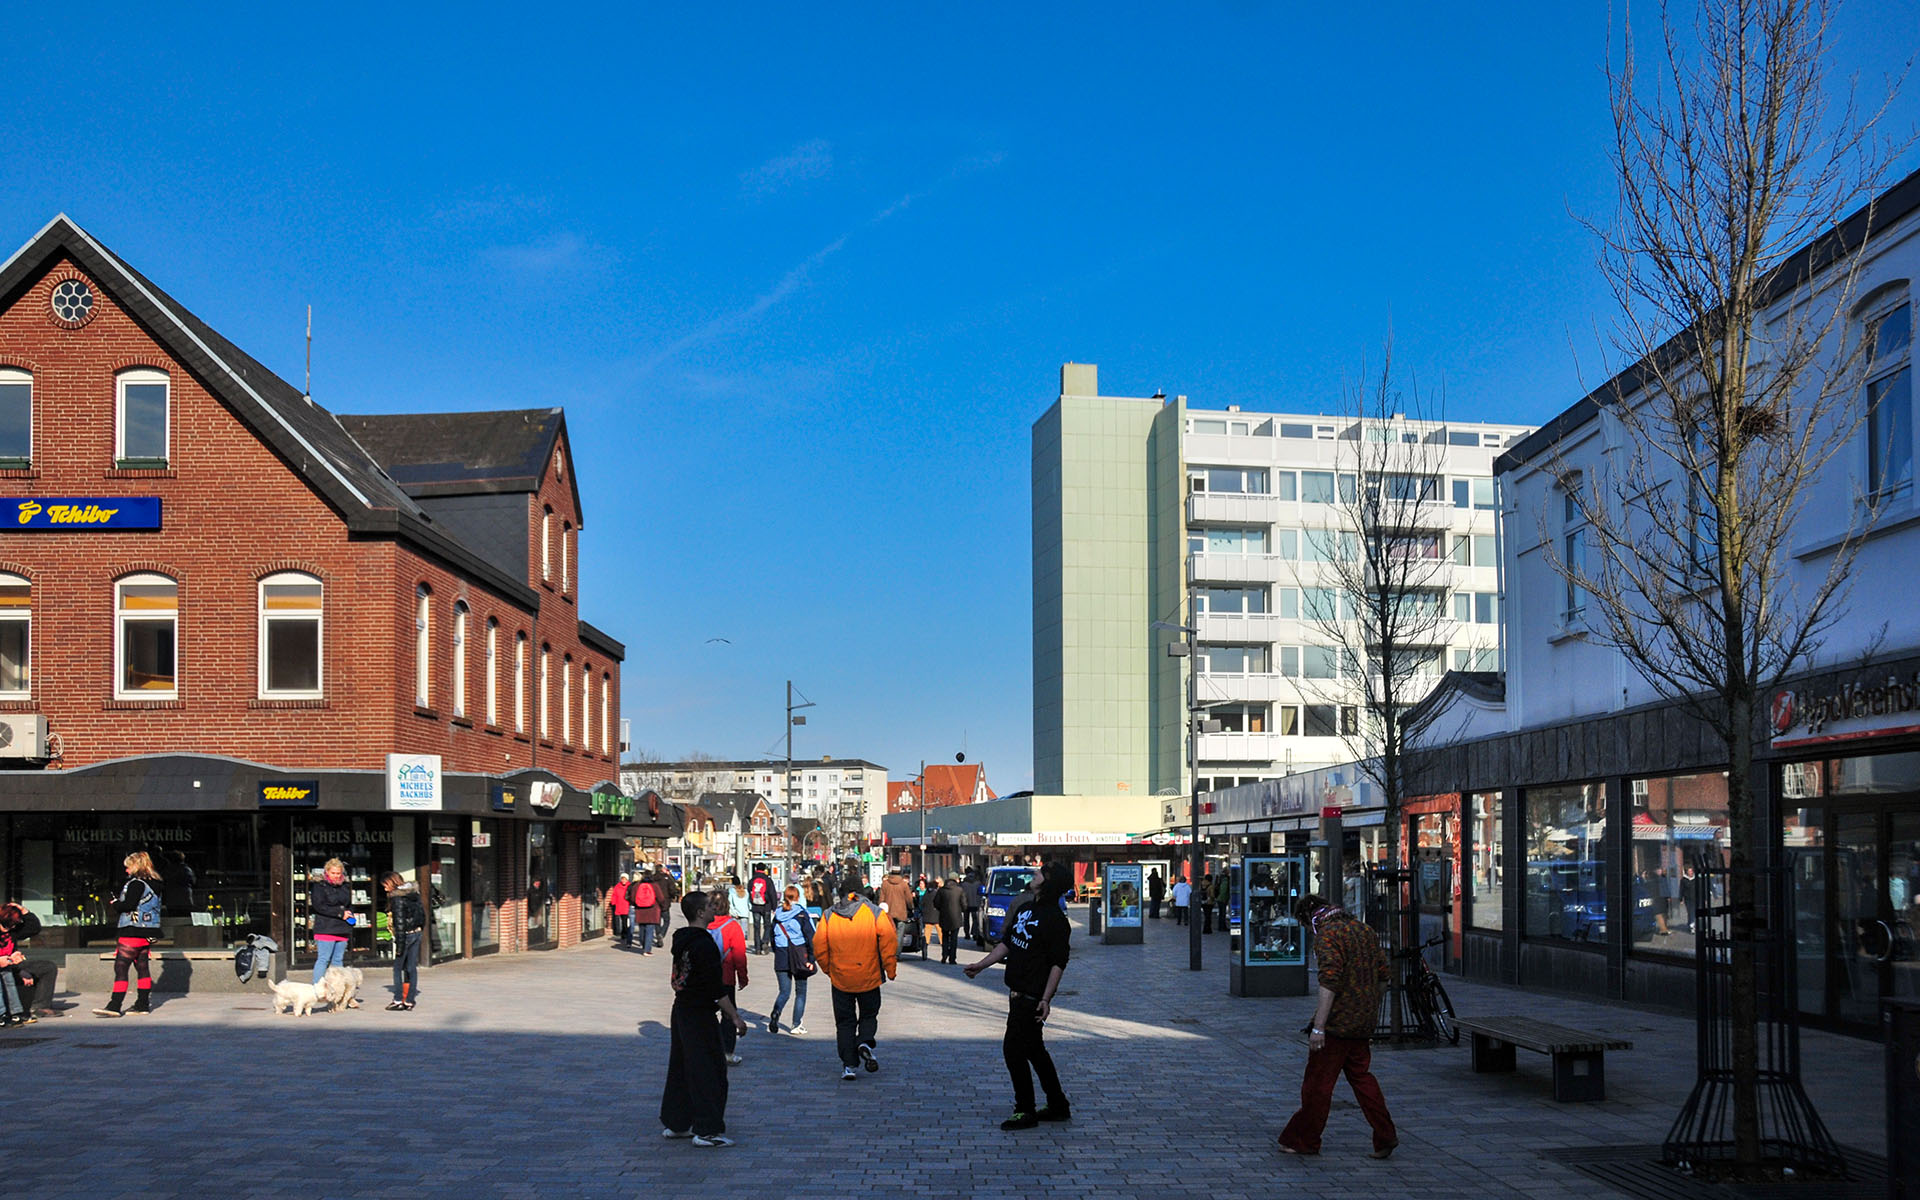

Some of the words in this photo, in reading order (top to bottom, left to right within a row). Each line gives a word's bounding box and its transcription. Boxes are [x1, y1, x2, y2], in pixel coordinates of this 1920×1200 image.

[47, 505, 119, 523] Tchibo
[263, 786, 310, 799] Tchibo
[400, 790, 433, 798] BACKHUS
[129, 828, 192, 841] BACKHUS
[1010, 934, 1029, 950] PAULI
